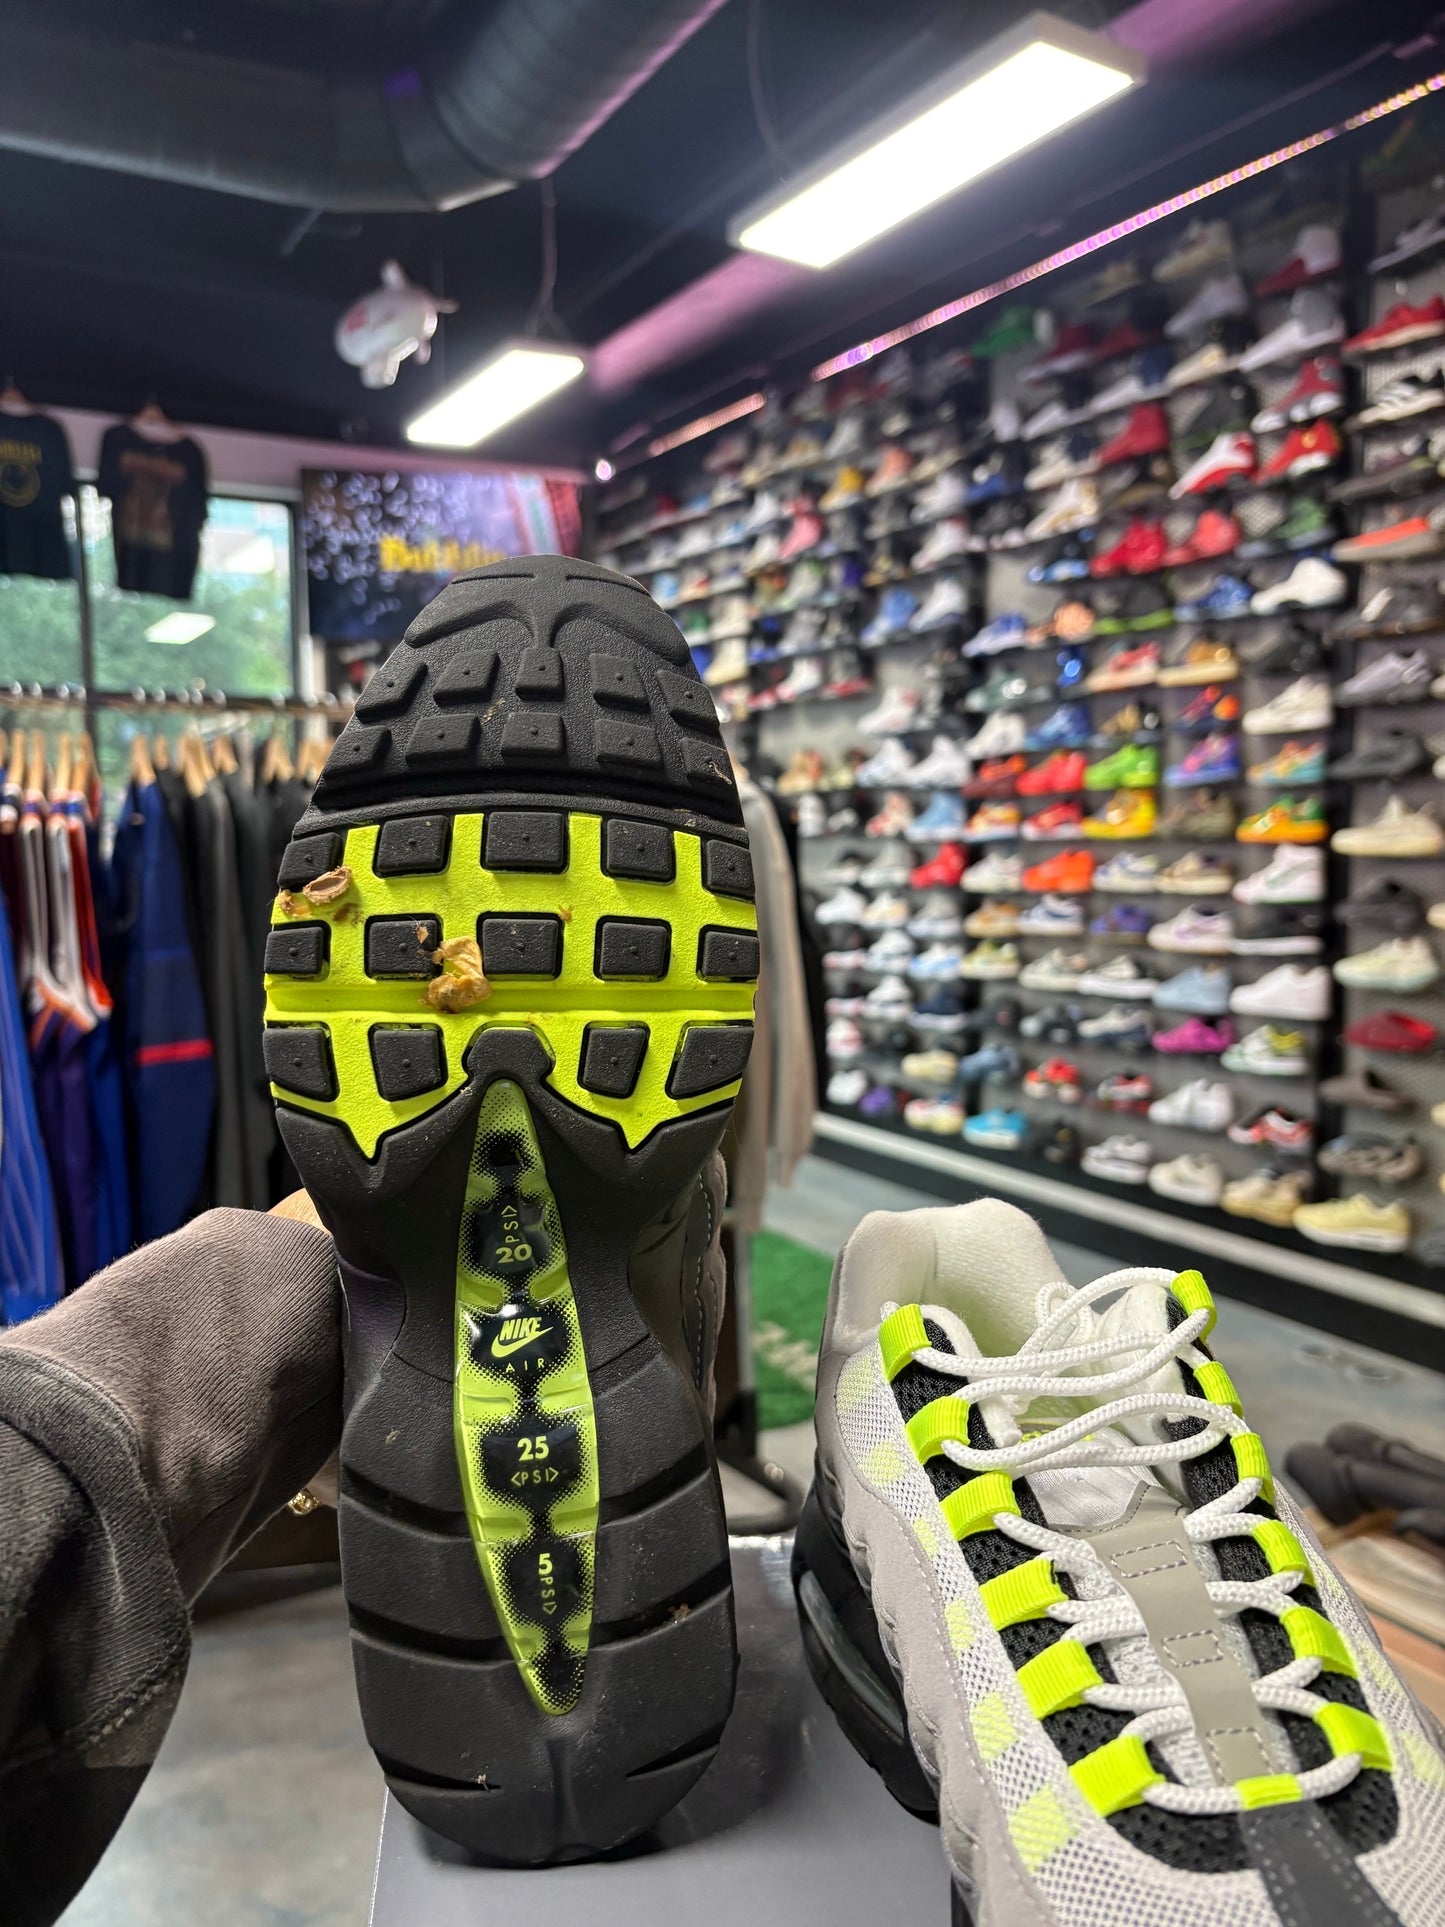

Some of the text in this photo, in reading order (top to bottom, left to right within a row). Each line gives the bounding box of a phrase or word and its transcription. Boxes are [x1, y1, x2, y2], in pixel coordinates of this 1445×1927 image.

[496, 1244, 532, 1264] 20
[500, 1317, 542, 1341] NIKE
[506, 1358, 544, 1373] AIR
[517, 1436, 550, 1461] 25
[538, 1553, 553, 1575] 5
